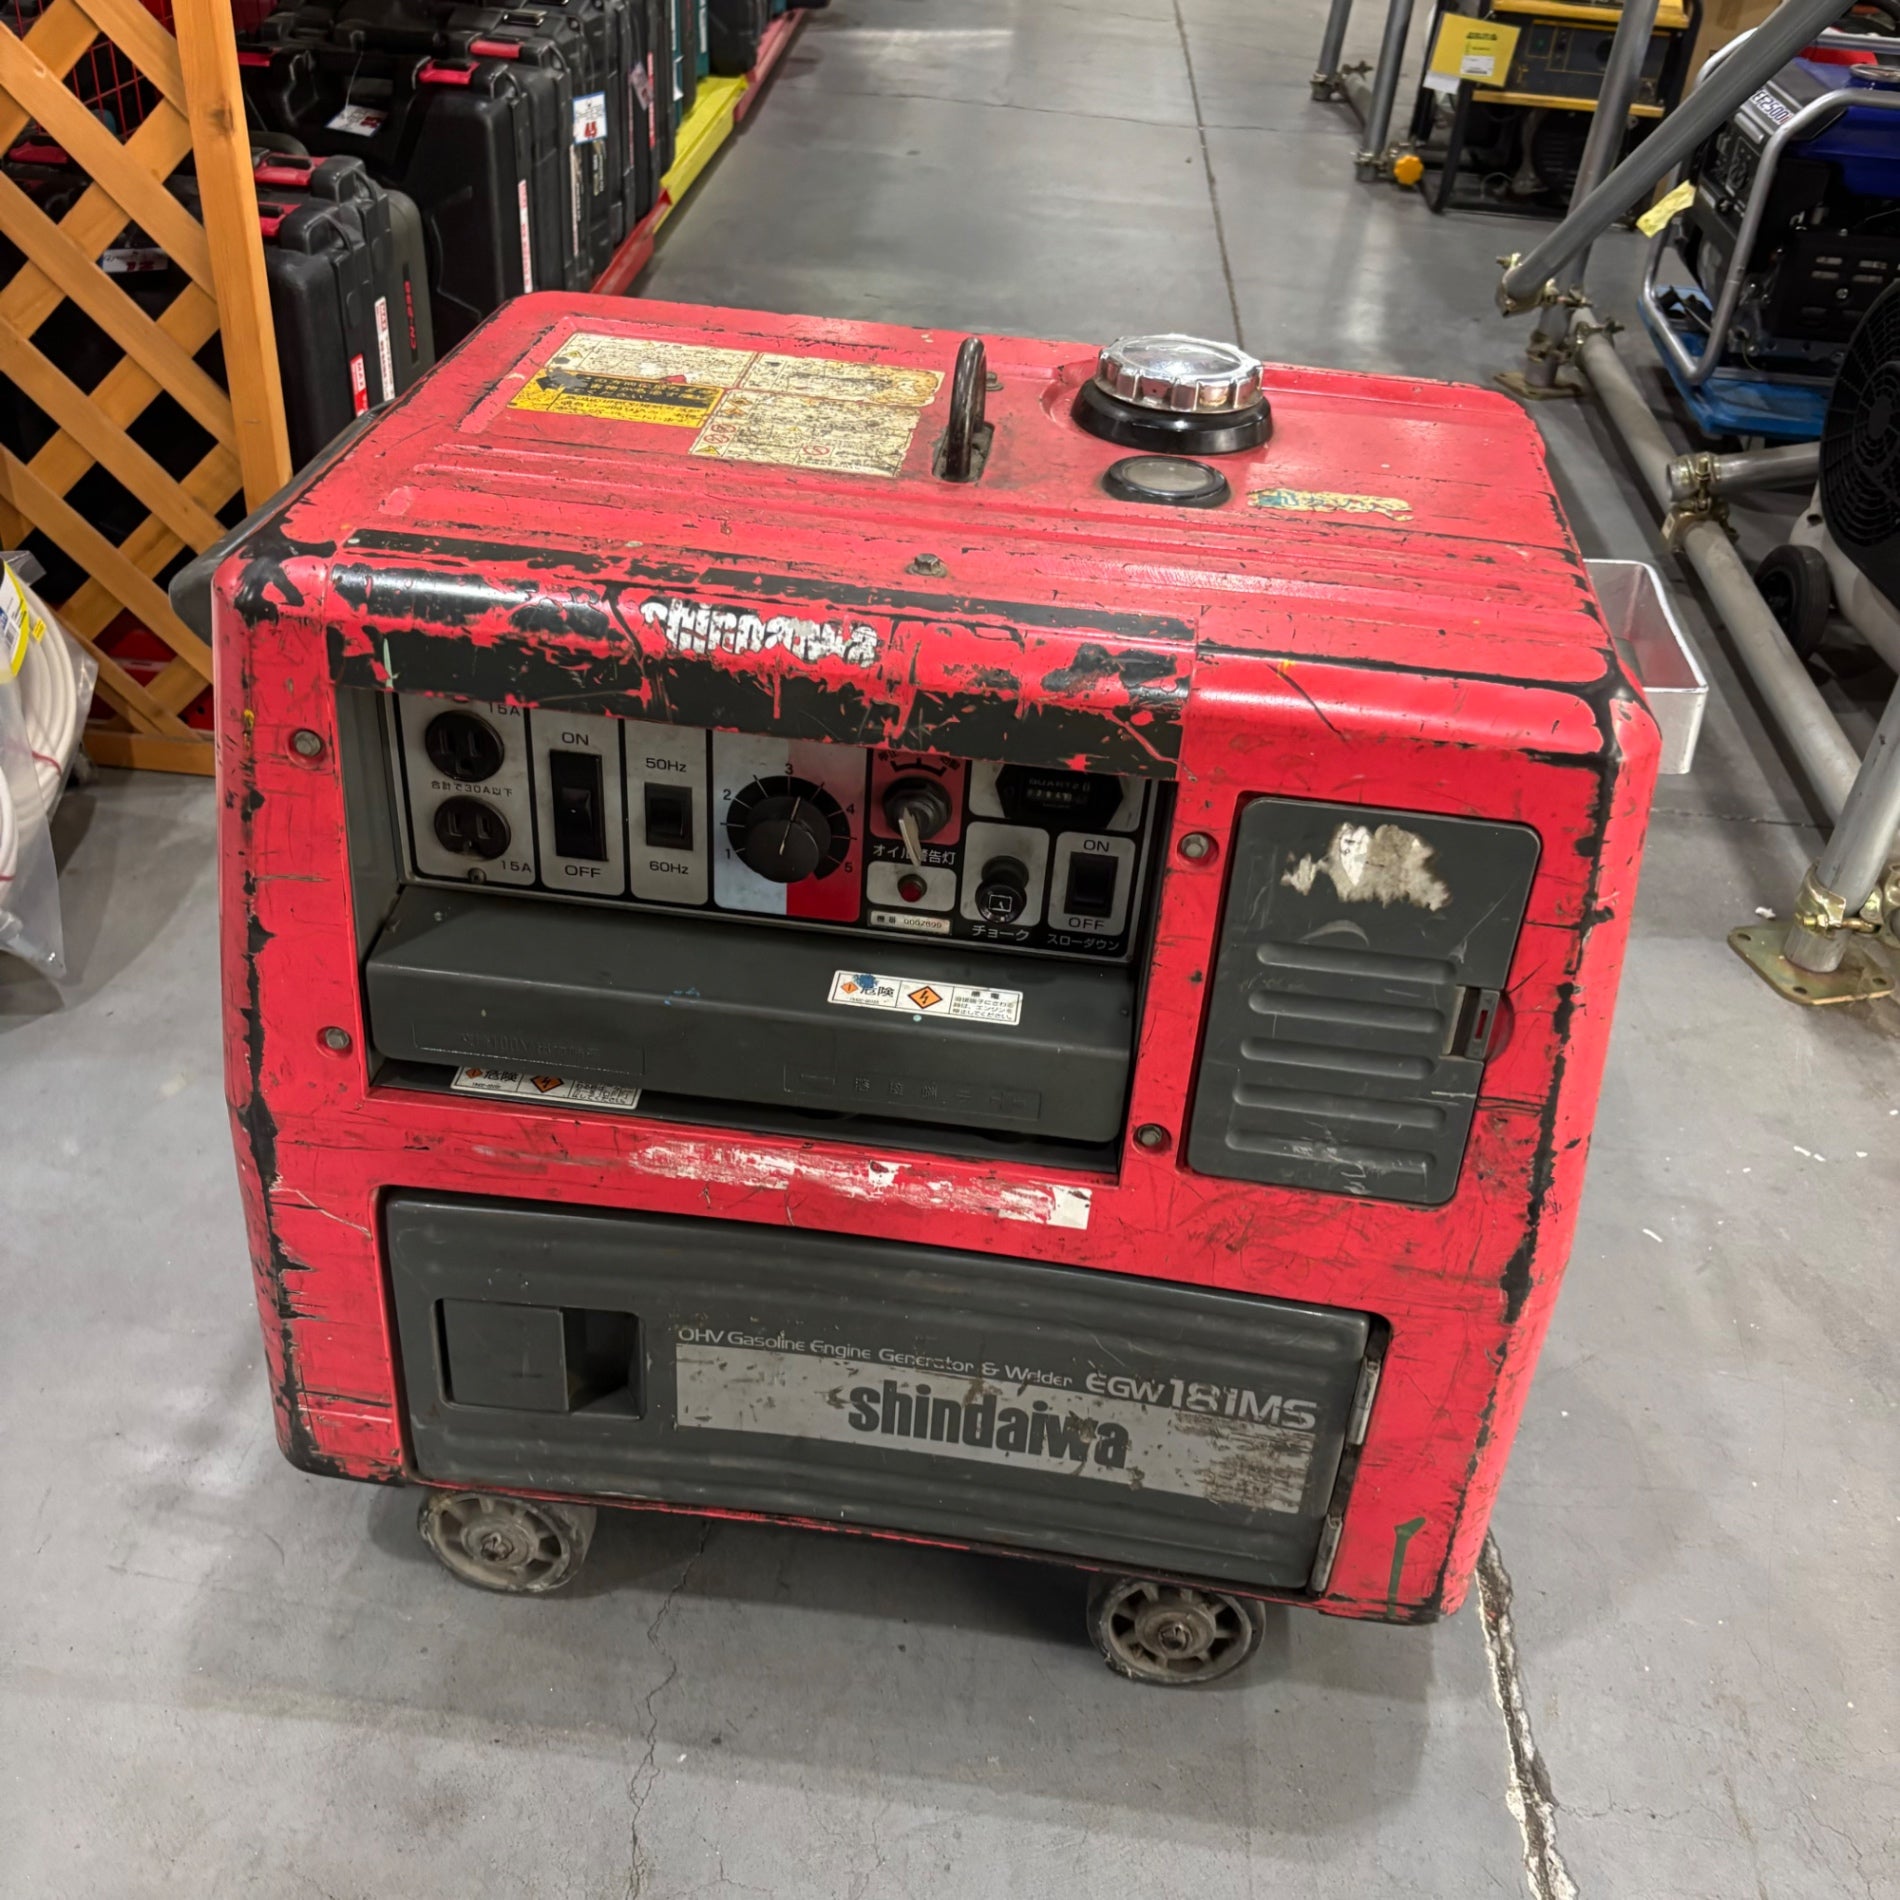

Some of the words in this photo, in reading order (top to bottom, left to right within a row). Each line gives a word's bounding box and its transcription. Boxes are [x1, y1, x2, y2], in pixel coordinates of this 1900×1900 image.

[561, 732, 589, 746] ON
[645, 757, 687, 773] 50Hz
[785, 763, 793, 775] 3
[723, 789, 731, 801] 2
[847, 803, 855, 815] 4
[1083, 839, 1110, 852] ON
[726, 849, 732, 860] 1
[501, 860, 533, 874] 15A
[564, 864, 601, 879] OFF
[649, 860, 689, 875] 60Hz
[844, 862, 853, 873] 5
[1069, 917, 1104, 931] OFF
[972, 925, 1030, 941] チョーク
[1048, 933, 1120, 951] スローダウン
[860, 985, 895, 998] 危険
[483, 1070, 518, 1082] 危険
[678, 1328, 725, 1343] OHV
[727, 1330, 805, 1352] Gasoline
[810, 1340, 871, 1360] Engine
[879, 1348, 974, 1373] Generator
[981, 1362, 1000, 1377] &
[1004, 1365, 1073, 1387] Welder
[1085, 1371, 1318, 1430] EGW181MS
[848, 1379, 1130, 1469] shindaiwa
